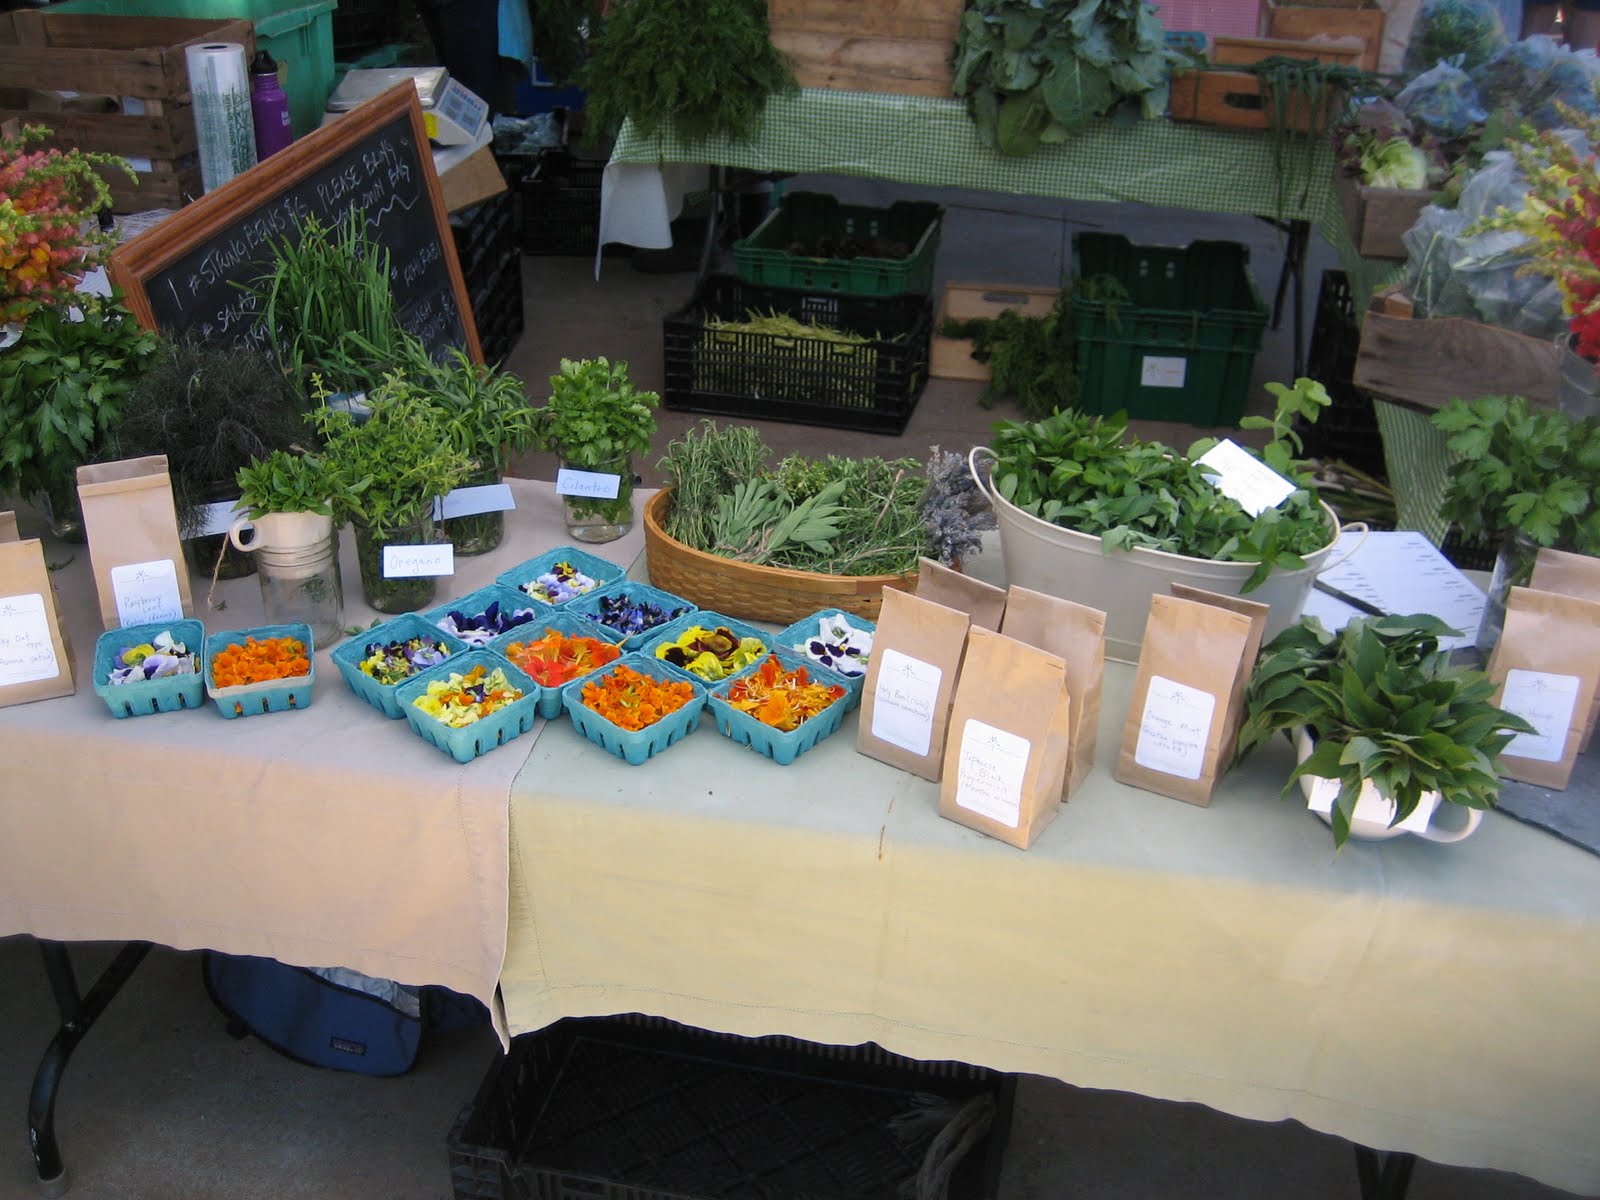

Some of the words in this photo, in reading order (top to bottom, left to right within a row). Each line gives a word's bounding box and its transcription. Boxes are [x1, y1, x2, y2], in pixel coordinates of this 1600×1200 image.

[317, 164, 363, 213] PLEASE
[363, 177, 386, 209] OWN
[243, 208, 286, 249] BEANS
[562, 476, 610, 494] Cilantro
[391, 554, 441, 575] Oregano
